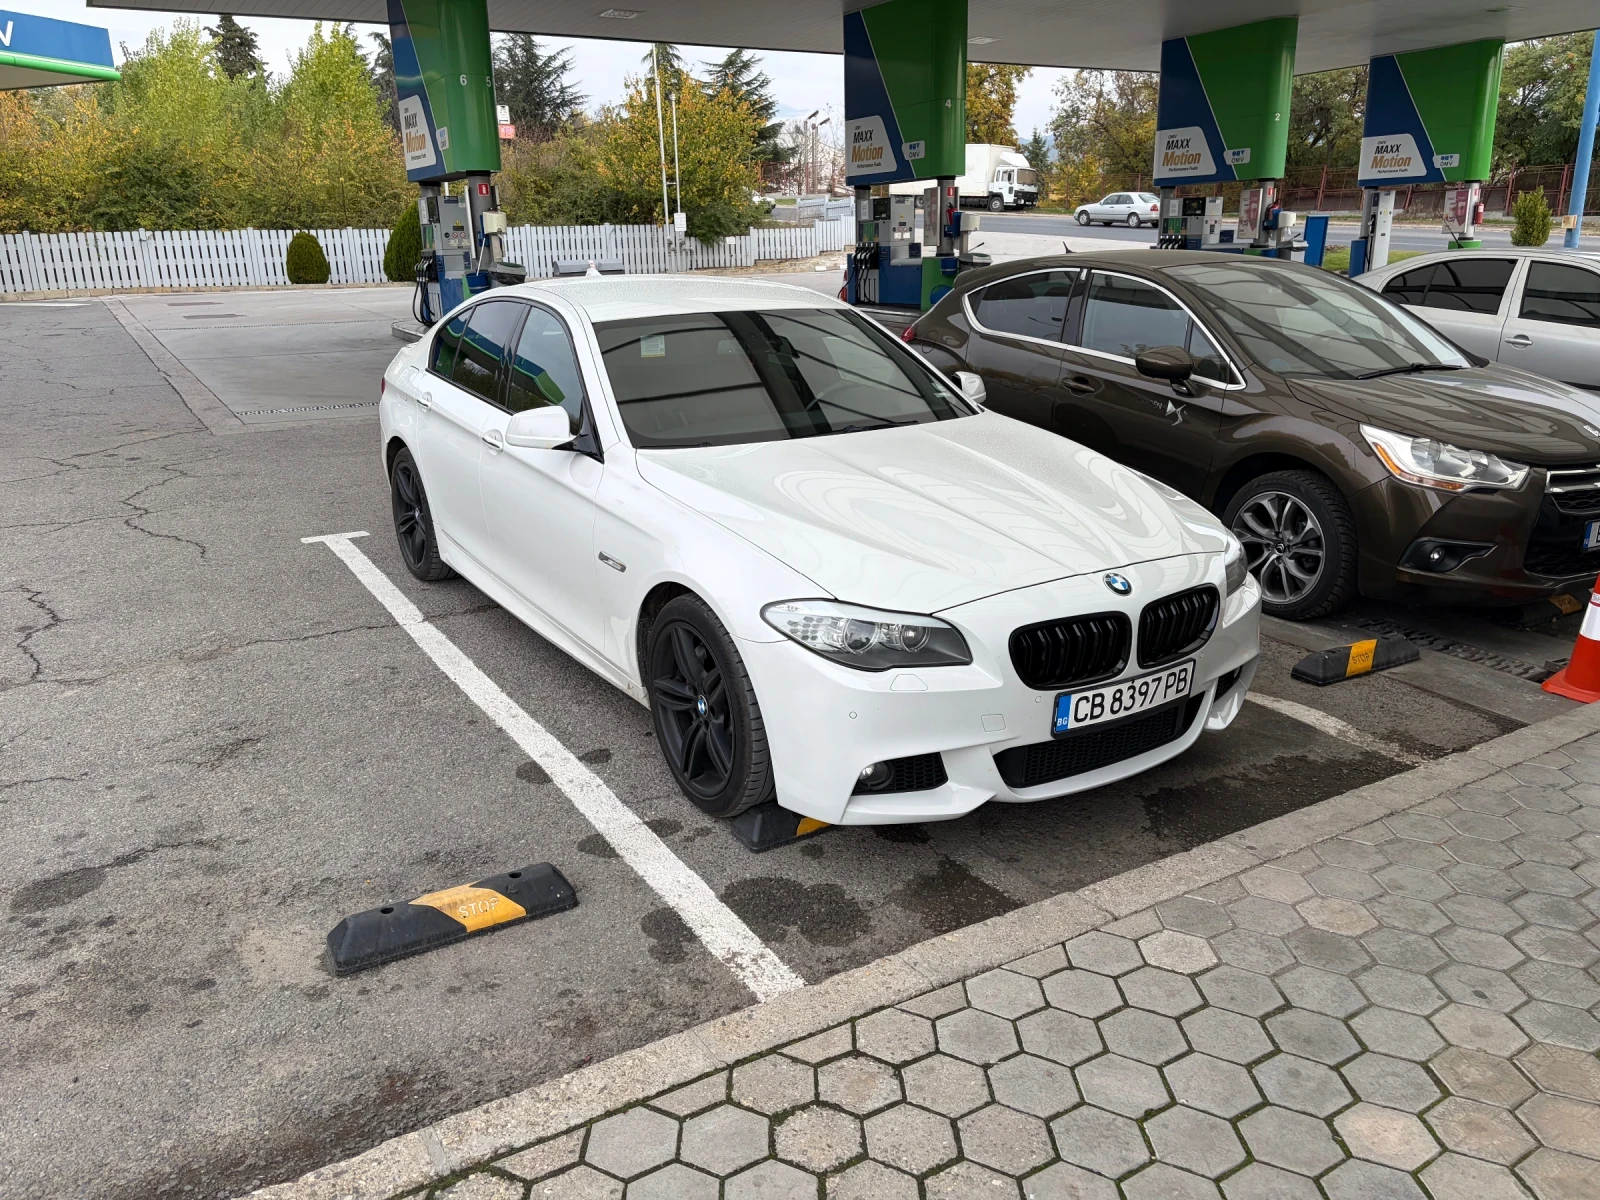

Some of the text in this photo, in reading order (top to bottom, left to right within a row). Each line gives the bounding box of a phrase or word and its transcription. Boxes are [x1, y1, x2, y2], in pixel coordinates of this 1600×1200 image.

[459, 74, 467, 86] 6
[486, 76, 492, 88] 5
[945, 98, 952, 109] 4
[1274, 112, 1281, 121] 2
[405, 131, 427, 154] Motion
[852, 129, 874, 144] MAXX
[1165, 138, 1192, 150] MAXX
[1374, 143, 1402, 155] MAXX
[851, 144, 884, 163] Motion
[908, 151, 920, 159] OMV
[1162, 151, 1202, 167] Motion
[1370, 155, 1412, 169] Motion
[1351, 651, 1370, 665] STOP
[1073, 667, 1188, 723] CB 8397 PB
[1056, 716, 1068, 727] BG
[458, 896, 500, 919] STOP
